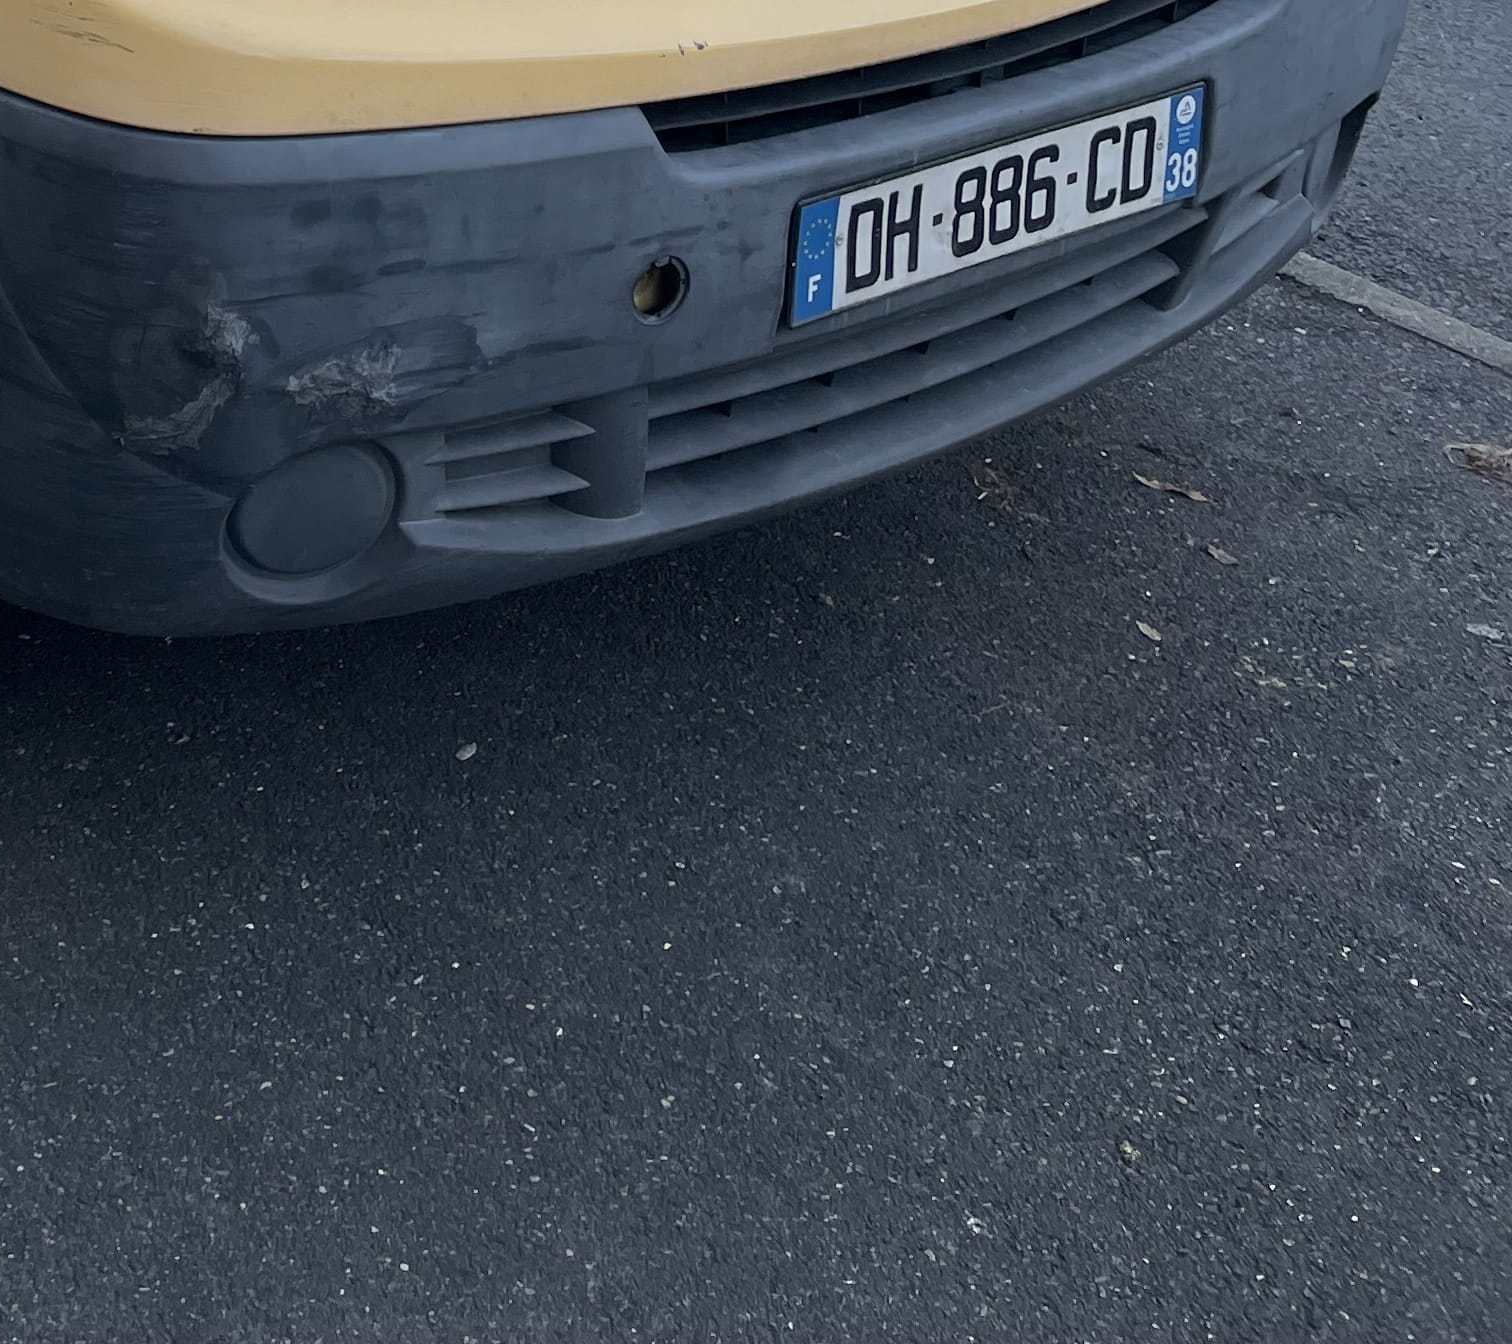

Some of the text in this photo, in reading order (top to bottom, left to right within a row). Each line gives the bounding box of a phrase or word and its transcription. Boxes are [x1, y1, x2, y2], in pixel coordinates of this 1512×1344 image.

[807, 274, 822, 303] F
[845, 116, 1157, 294] DH-886-CD
[1166, 148, 1197, 192] 38
